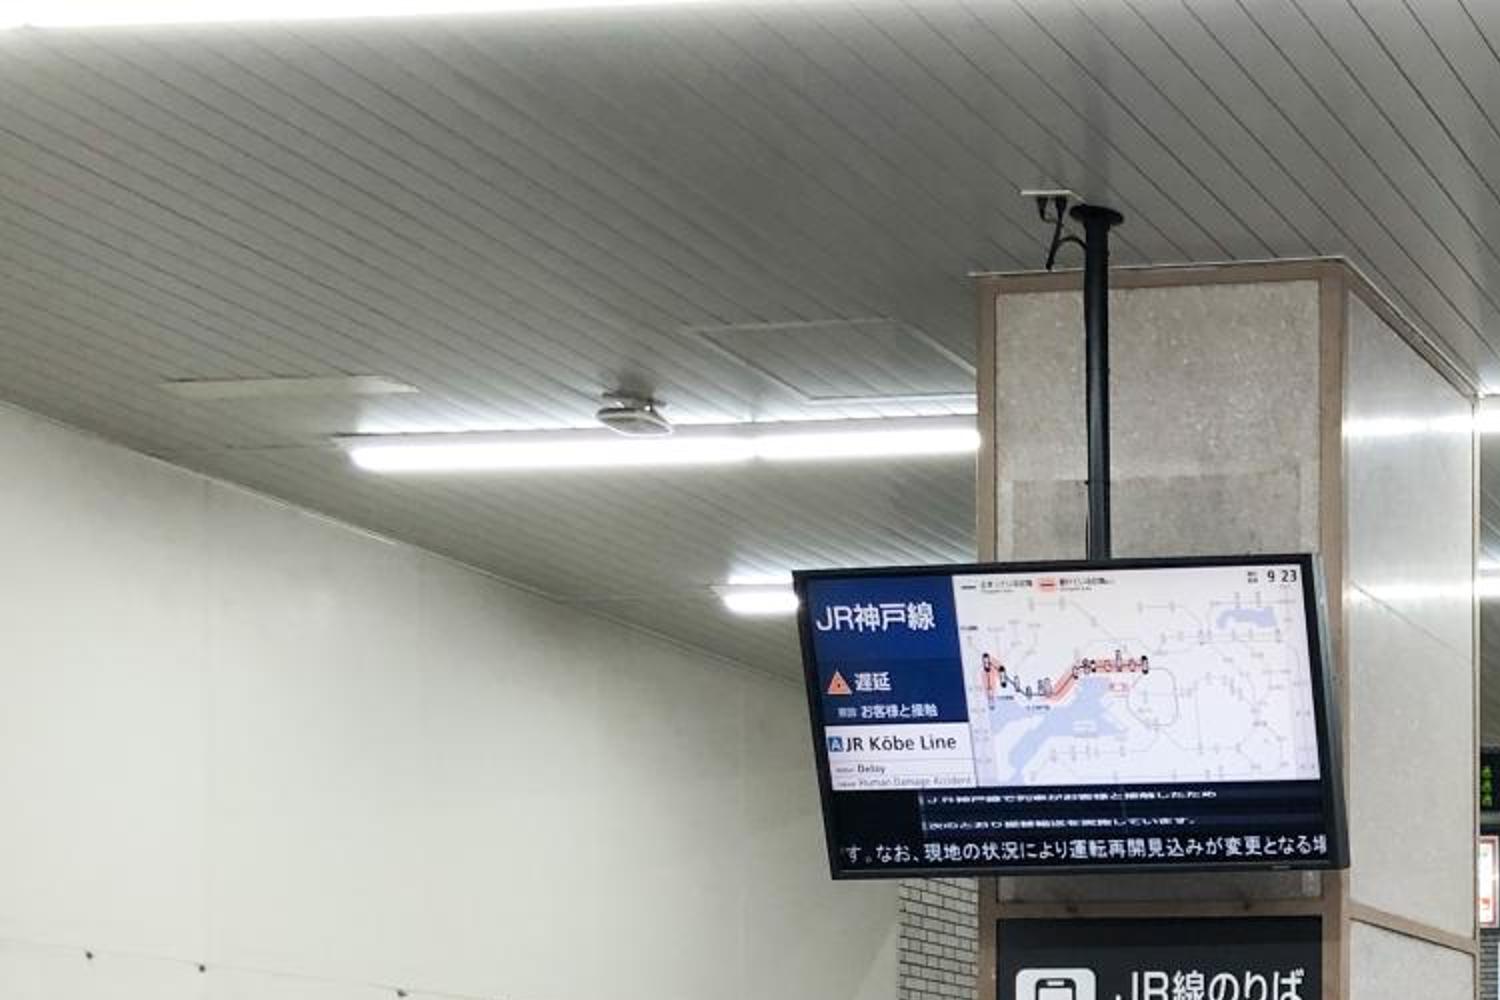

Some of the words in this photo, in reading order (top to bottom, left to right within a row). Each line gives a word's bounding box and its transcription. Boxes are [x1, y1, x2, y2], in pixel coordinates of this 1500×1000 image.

[815, 602, 936, 632] JR神戸線
[854, 671, 892, 691] 遅延
[846, 736, 863, 753] JR
[921, 733, 957, 751] Line
